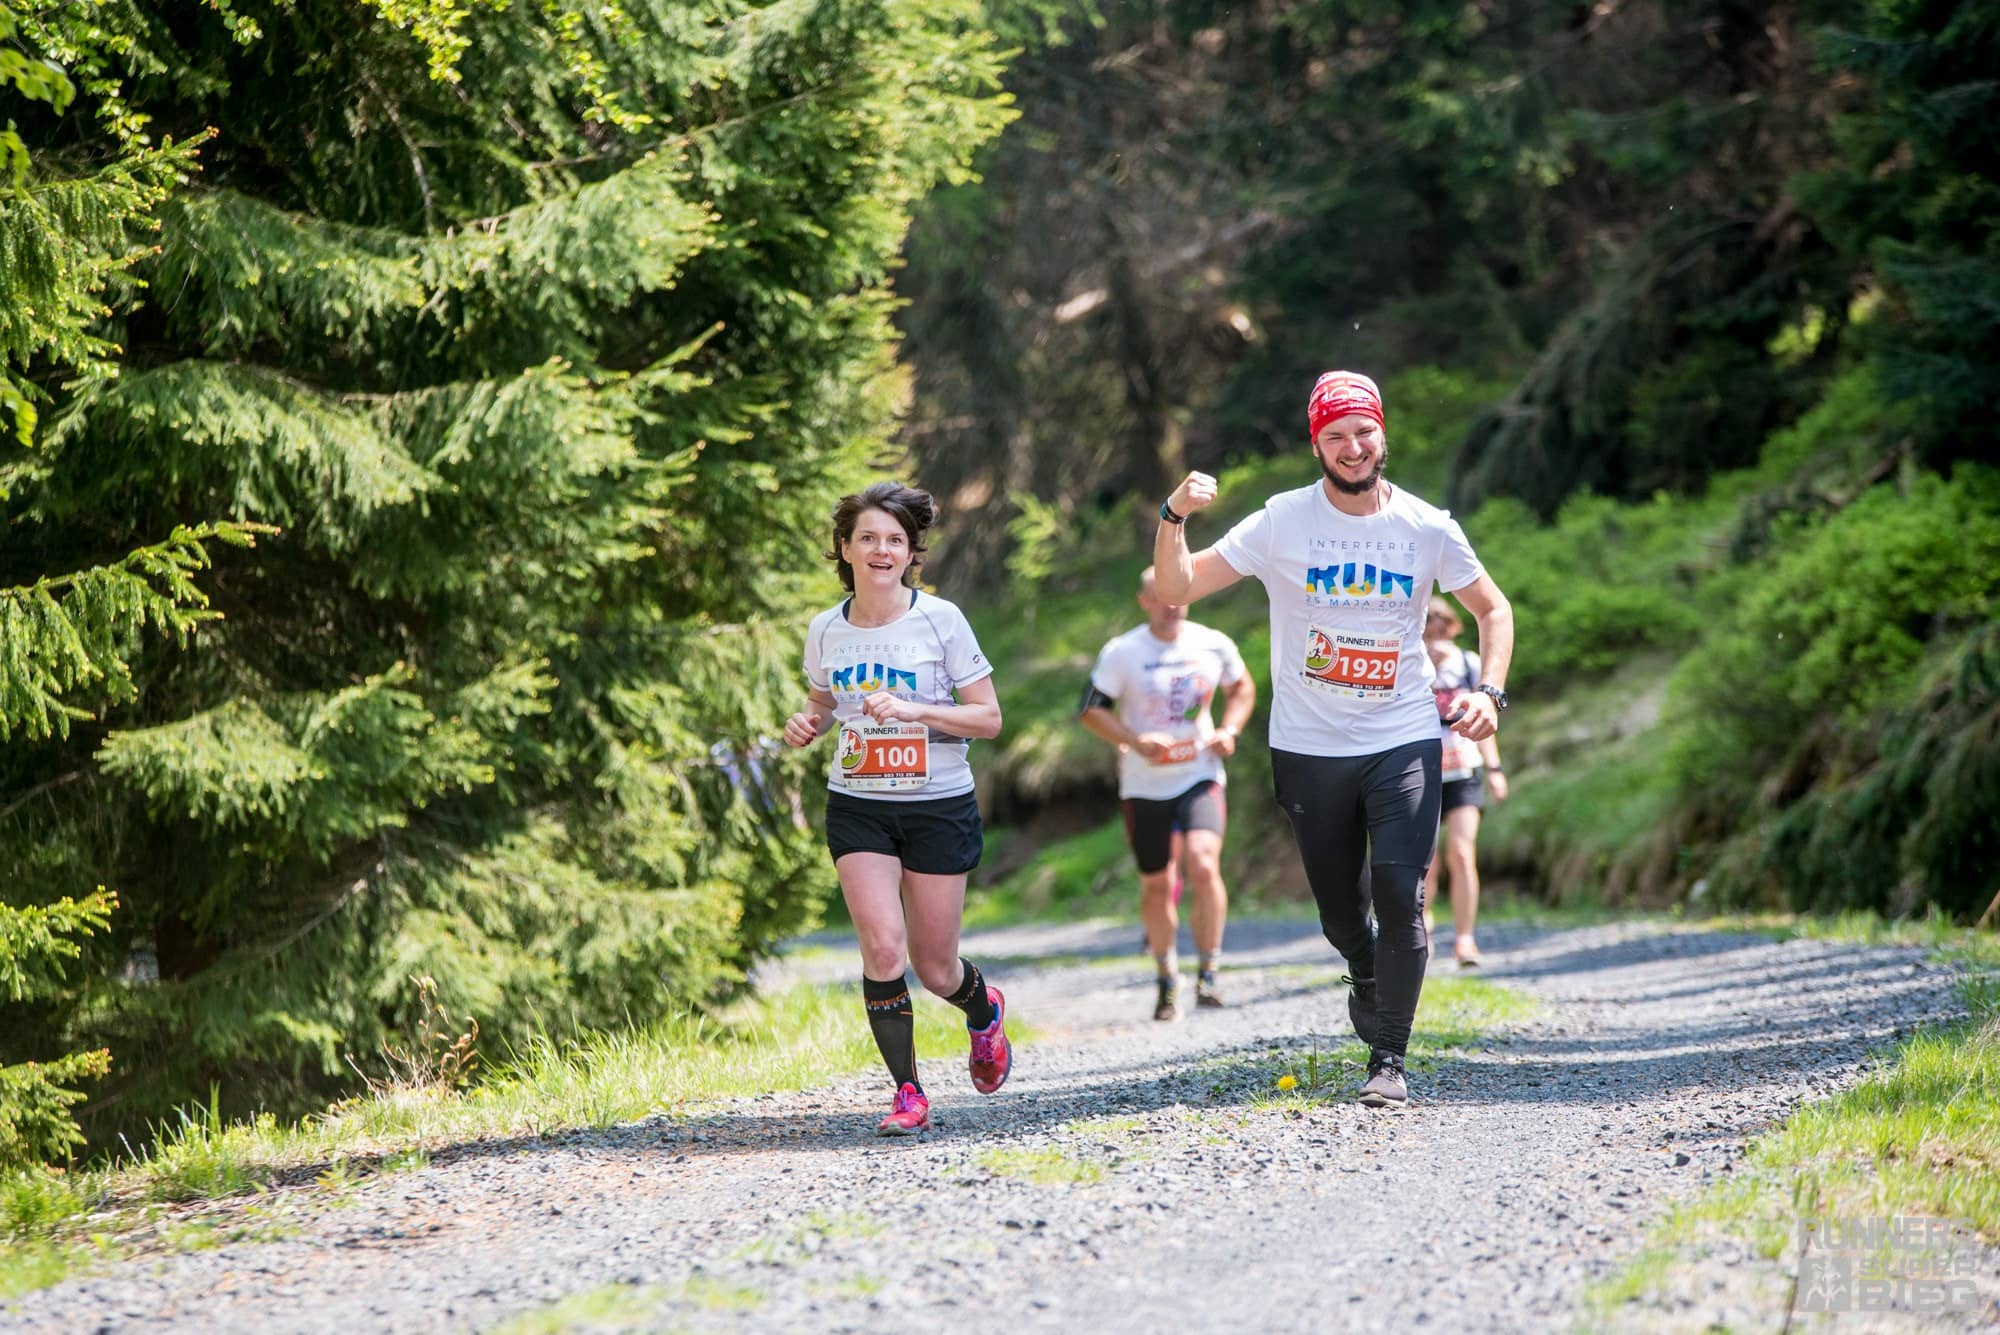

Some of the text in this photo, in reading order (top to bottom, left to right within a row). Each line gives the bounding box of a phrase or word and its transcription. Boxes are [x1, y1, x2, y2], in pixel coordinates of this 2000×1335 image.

[1308, 539, 1416, 552] INTERFERIE
[1305, 562, 1414, 599] RUN
[1329, 599, 1370, 607] MAJA
[832, 644, 918, 655] INTERFERIE
[832, 662, 917, 693] RUN
[1340, 656, 1396, 680] 1929
[874, 746, 918, 768] 100
